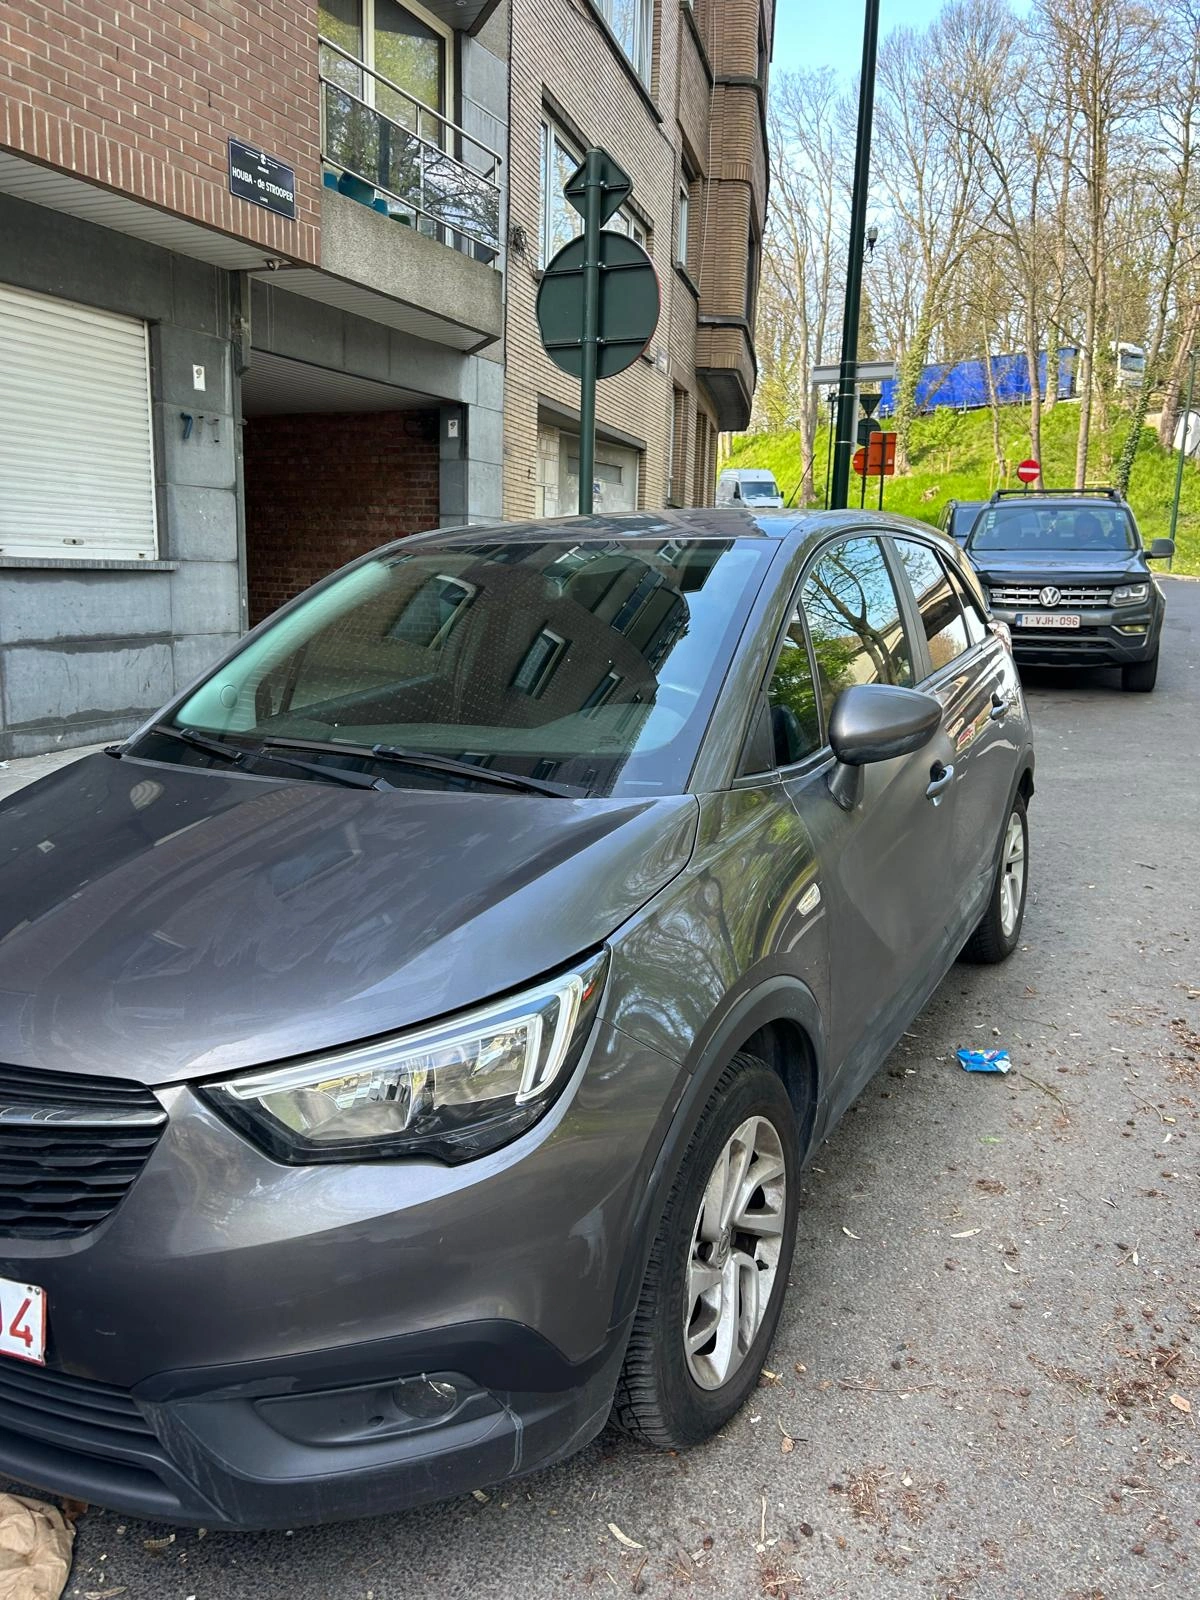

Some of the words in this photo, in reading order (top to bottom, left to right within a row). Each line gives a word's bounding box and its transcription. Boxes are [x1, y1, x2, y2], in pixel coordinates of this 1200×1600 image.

[232, 166, 253, 184] HOUBA
[257, 178, 265, 189] de
[265, 181, 294, 203] STROOPER
[180, 412, 193, 439] 7
[1024, 616, 1078, 625] 1-VJH-096
[0, 1297, 33, 1348] 4
